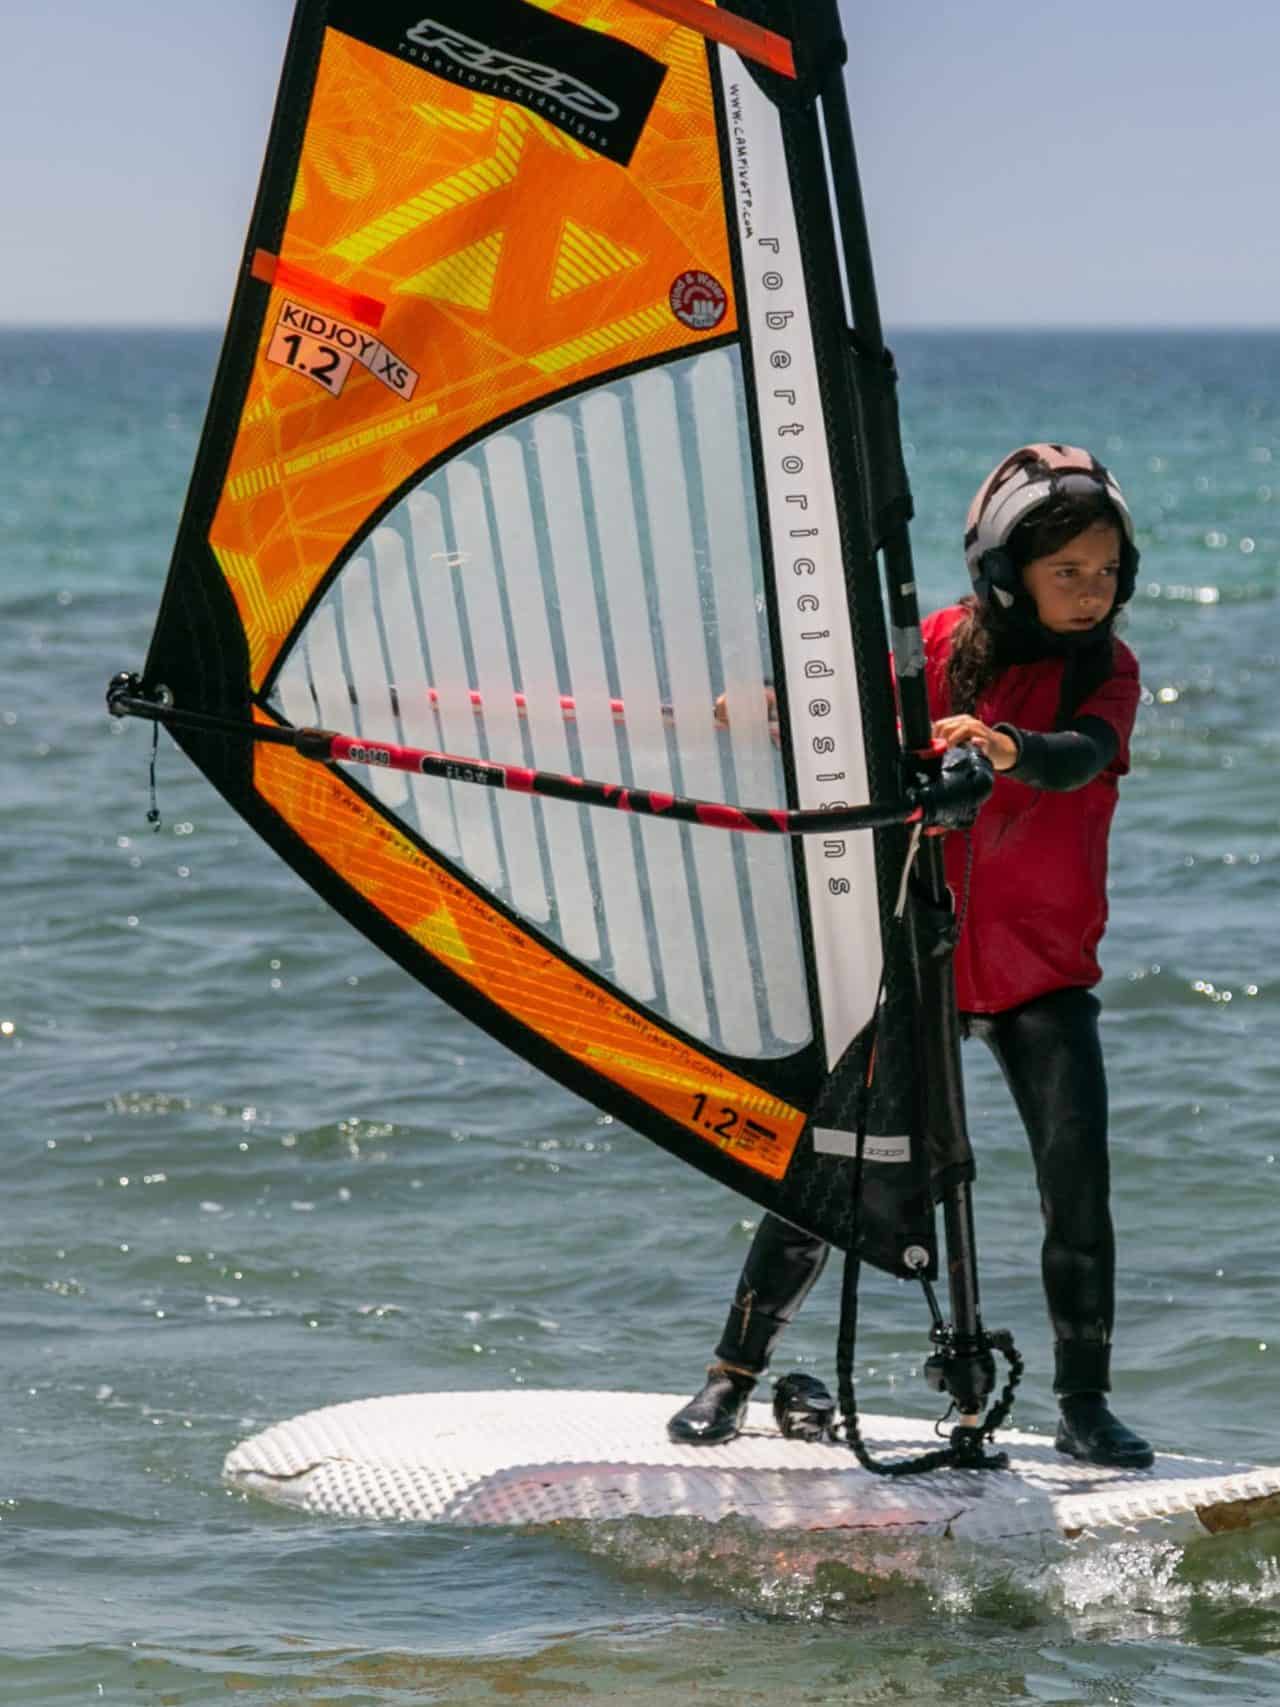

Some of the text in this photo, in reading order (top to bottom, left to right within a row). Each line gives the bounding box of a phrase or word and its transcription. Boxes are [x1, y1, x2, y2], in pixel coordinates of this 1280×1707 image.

[283, 305, 409, 390] KIDJOY XS
[283, 334, 341, 386] 1.2
[692, 1093, 739, 1139] 1.2
